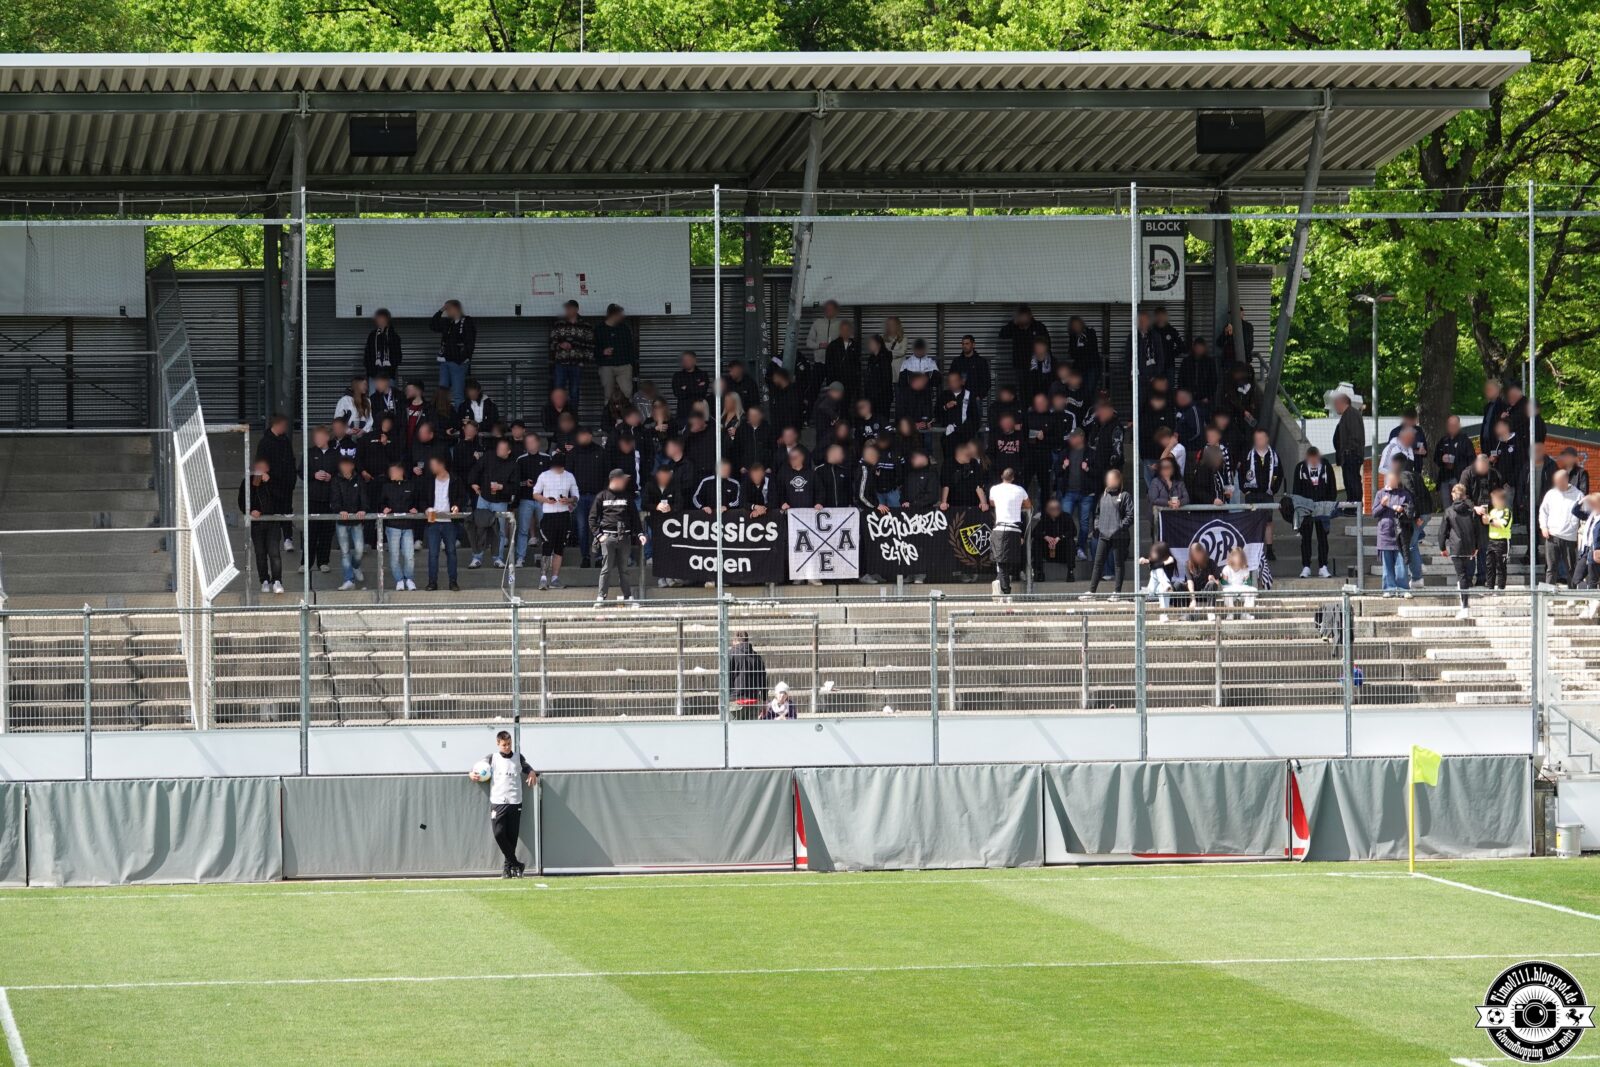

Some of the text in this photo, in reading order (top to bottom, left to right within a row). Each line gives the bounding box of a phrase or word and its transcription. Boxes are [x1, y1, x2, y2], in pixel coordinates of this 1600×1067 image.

[1145, 221, 1181, 231] BLOCK
[1149, 244, 1180, 292] D
[662, 513, 779, 542] classics
[688, 554, 752, 573] aaen
